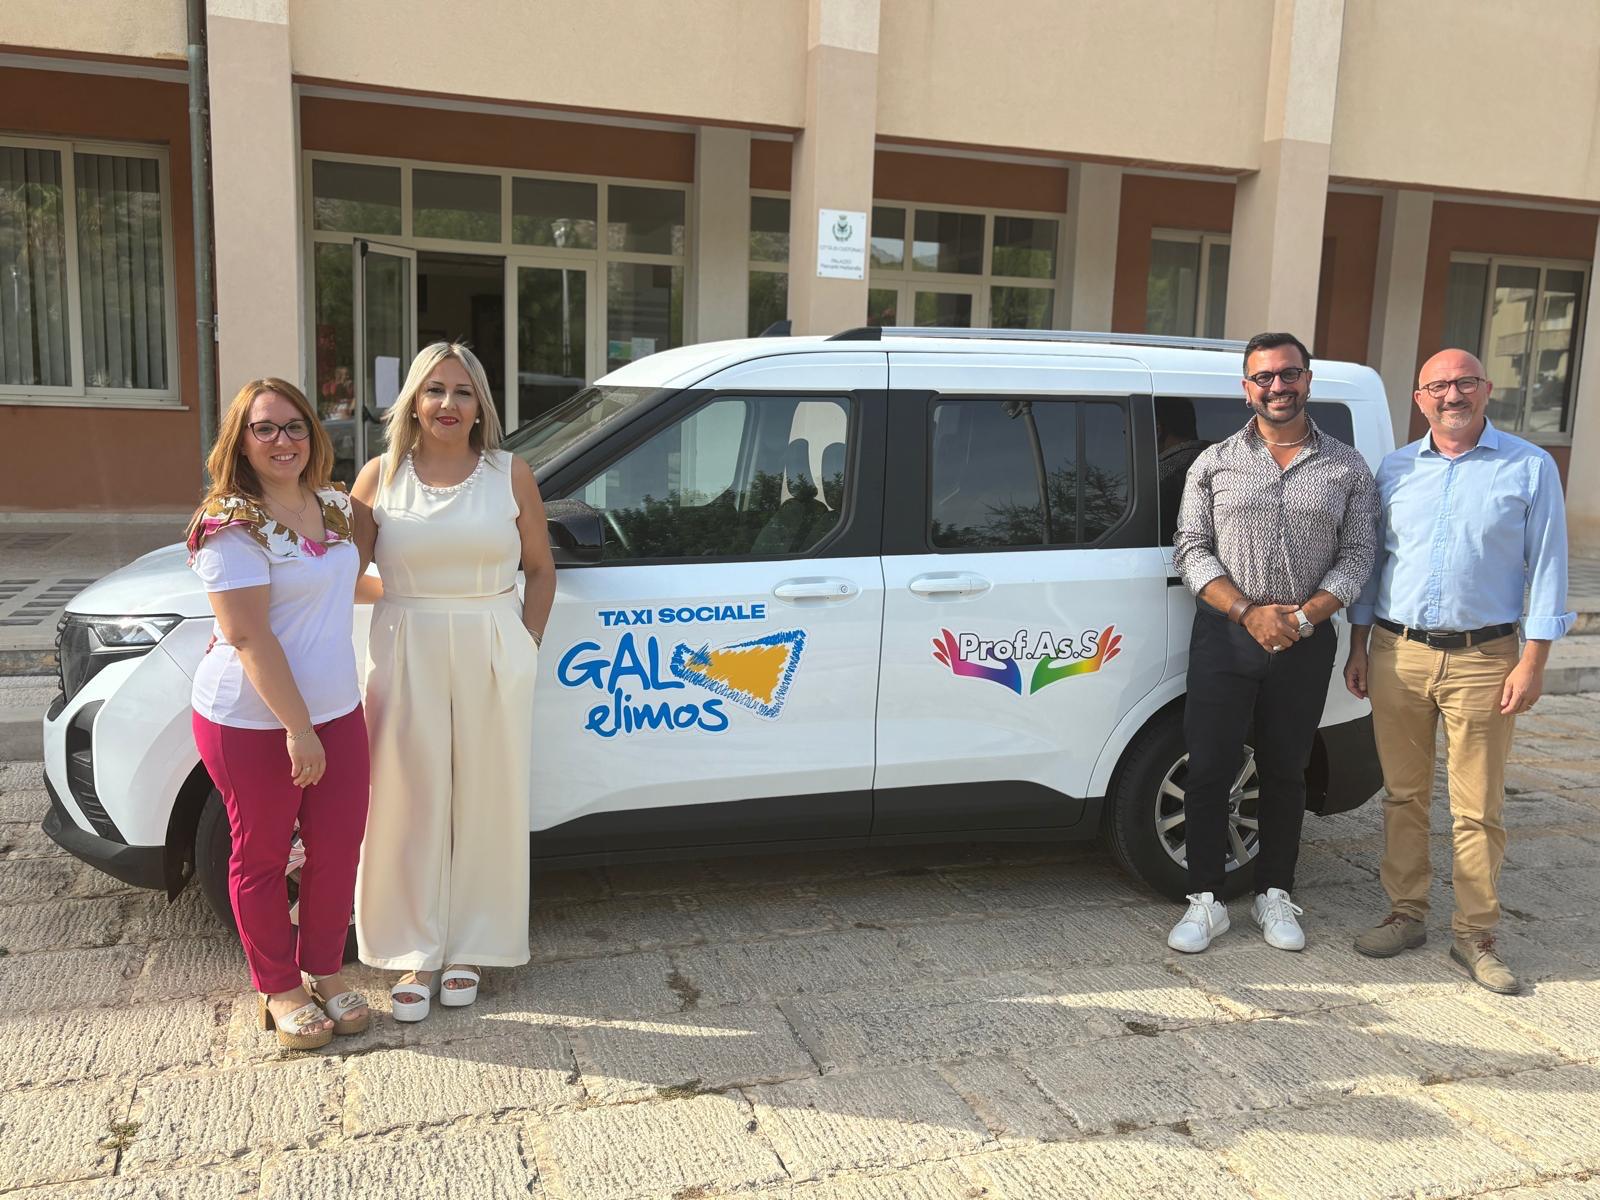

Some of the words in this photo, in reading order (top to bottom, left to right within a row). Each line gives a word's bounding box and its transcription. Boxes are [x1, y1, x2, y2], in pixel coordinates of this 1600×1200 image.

[598, 609, 653, 627] TAXI
[658, 604, 766, 624] SOCIALE
[557, 632, 685, 694] GAL
[958, 629, 1100, 662] Prof.As.S
[584, 687, 729, 737] elimos
